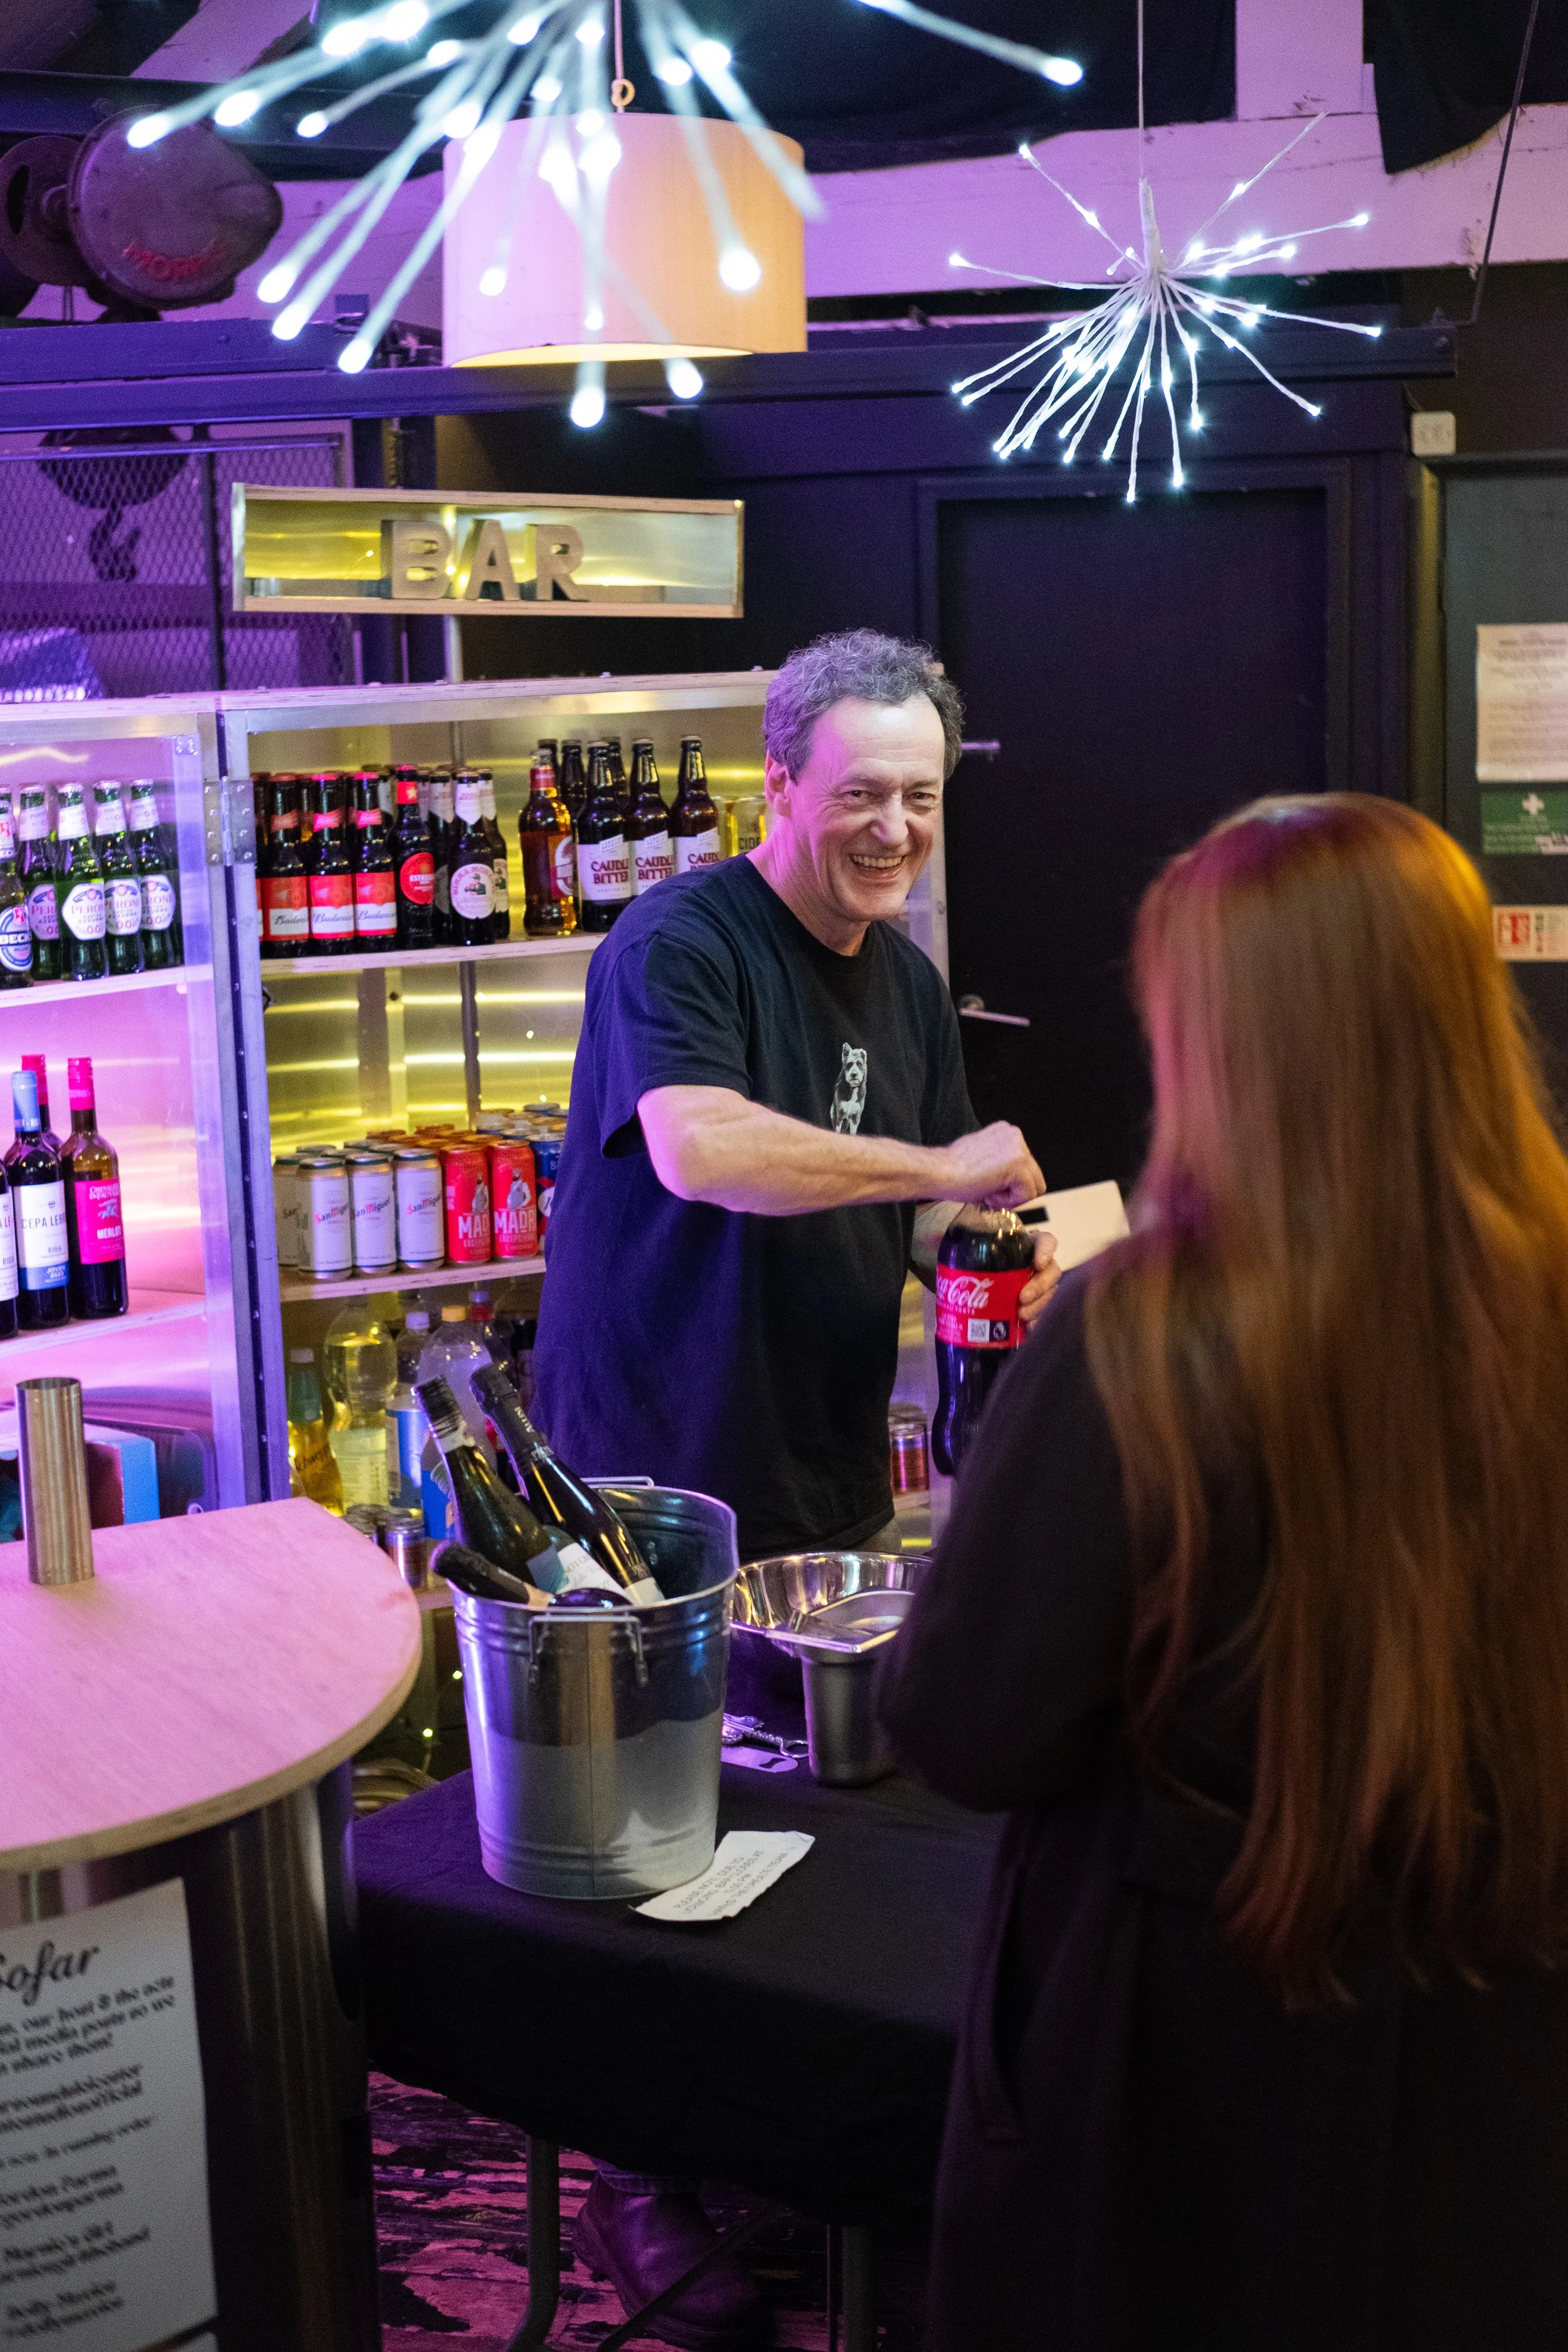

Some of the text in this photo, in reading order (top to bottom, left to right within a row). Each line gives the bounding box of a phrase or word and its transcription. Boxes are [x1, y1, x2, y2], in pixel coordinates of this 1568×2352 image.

[381, 518, 590, 602] BAR
[23, 1217, 48, 1229] CEPA
[97, 1224, 121, 1239] MERLOT
